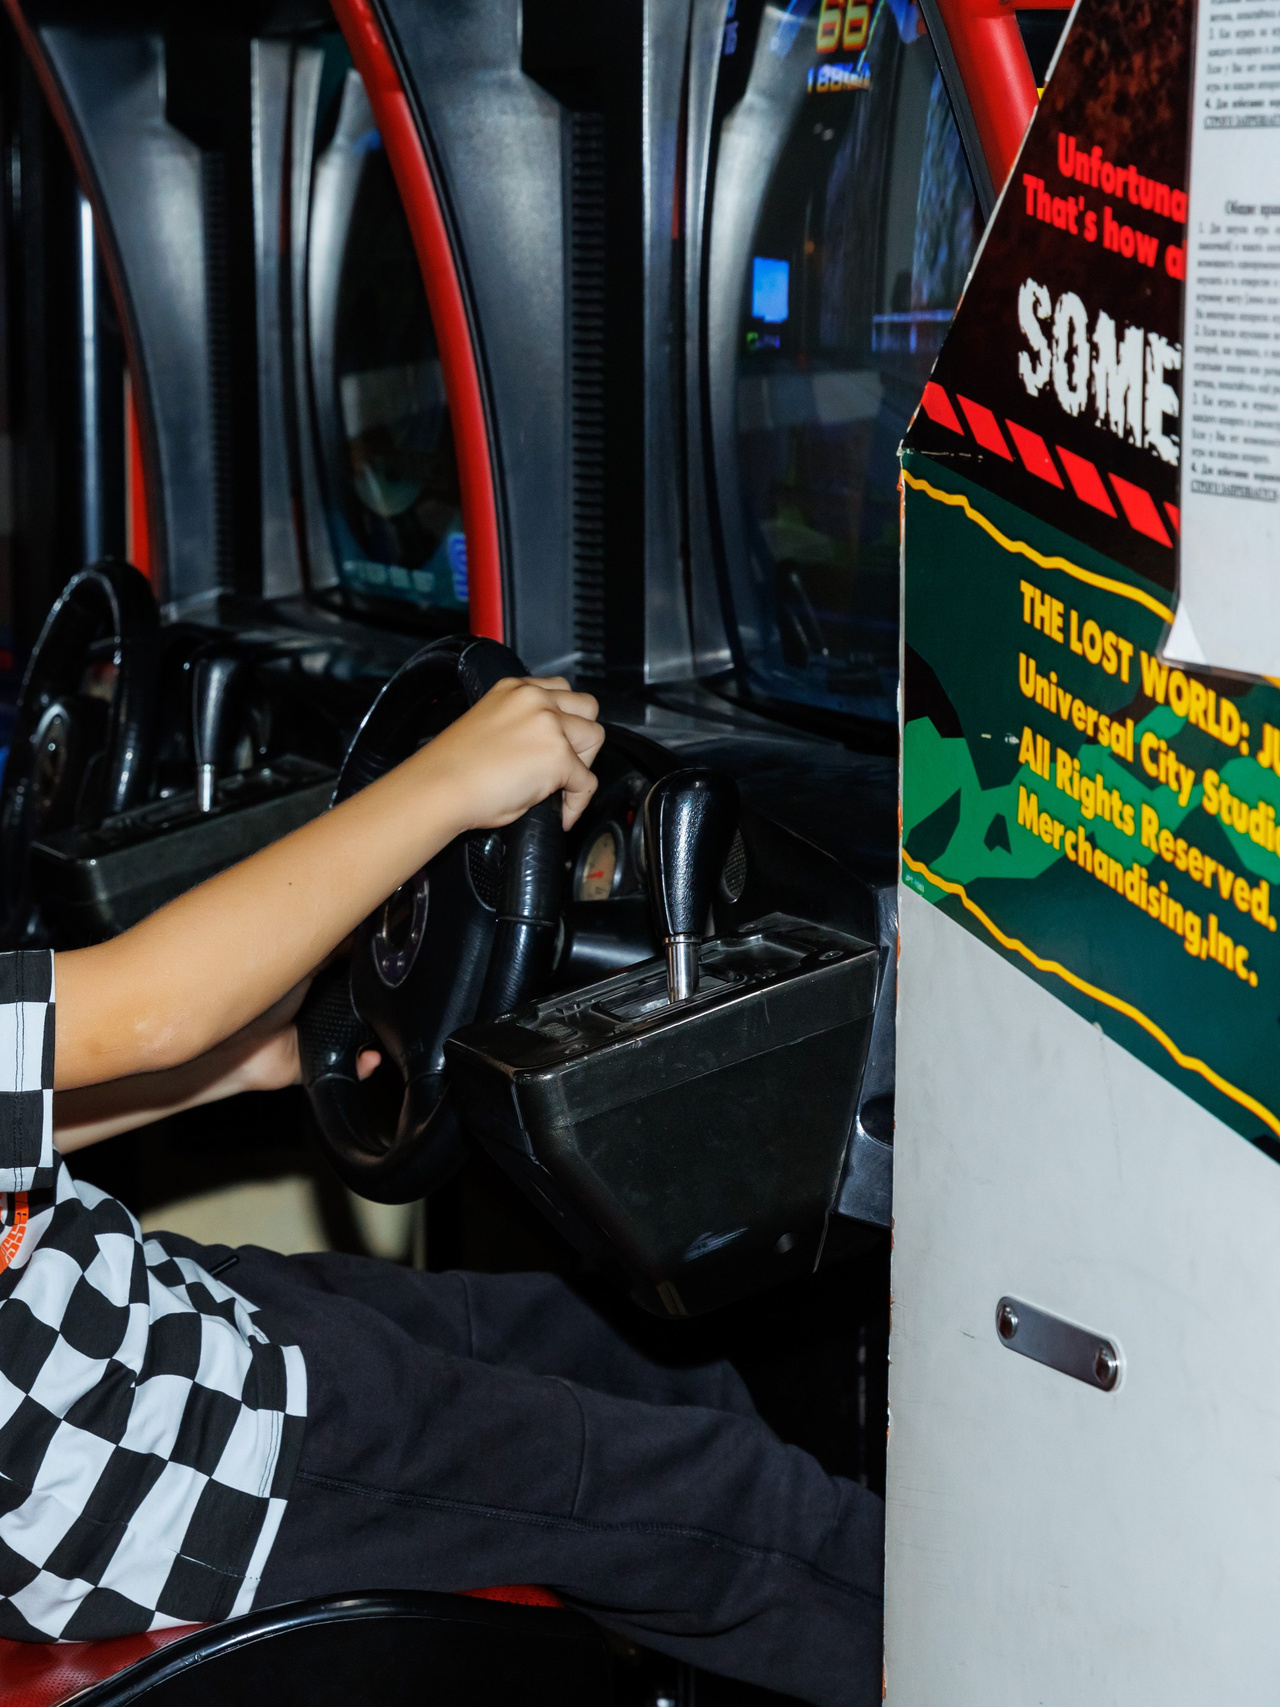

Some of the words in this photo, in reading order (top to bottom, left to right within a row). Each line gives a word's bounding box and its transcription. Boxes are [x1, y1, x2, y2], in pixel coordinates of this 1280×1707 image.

[1022, 173, 1097, 242] That's
[1103, 205, 1159, 268] how
[1057, 132, 1188, 223] Unfortuna
[1018, 277, 1182, 467] SOME
[1018, 652, 1134, 763] Universal
[1140, 732, 1195, 807] City
[1020, 579, 1064, 644] THE
[1070, 608, 1134, 683] LOST
[1139, 650, 1250, 756] WORLD:
[1018, 726, 1050, 781] All
[1056, 747, 1135, 836] Rights
[1141, 803, 1277, 932] Reserved.
